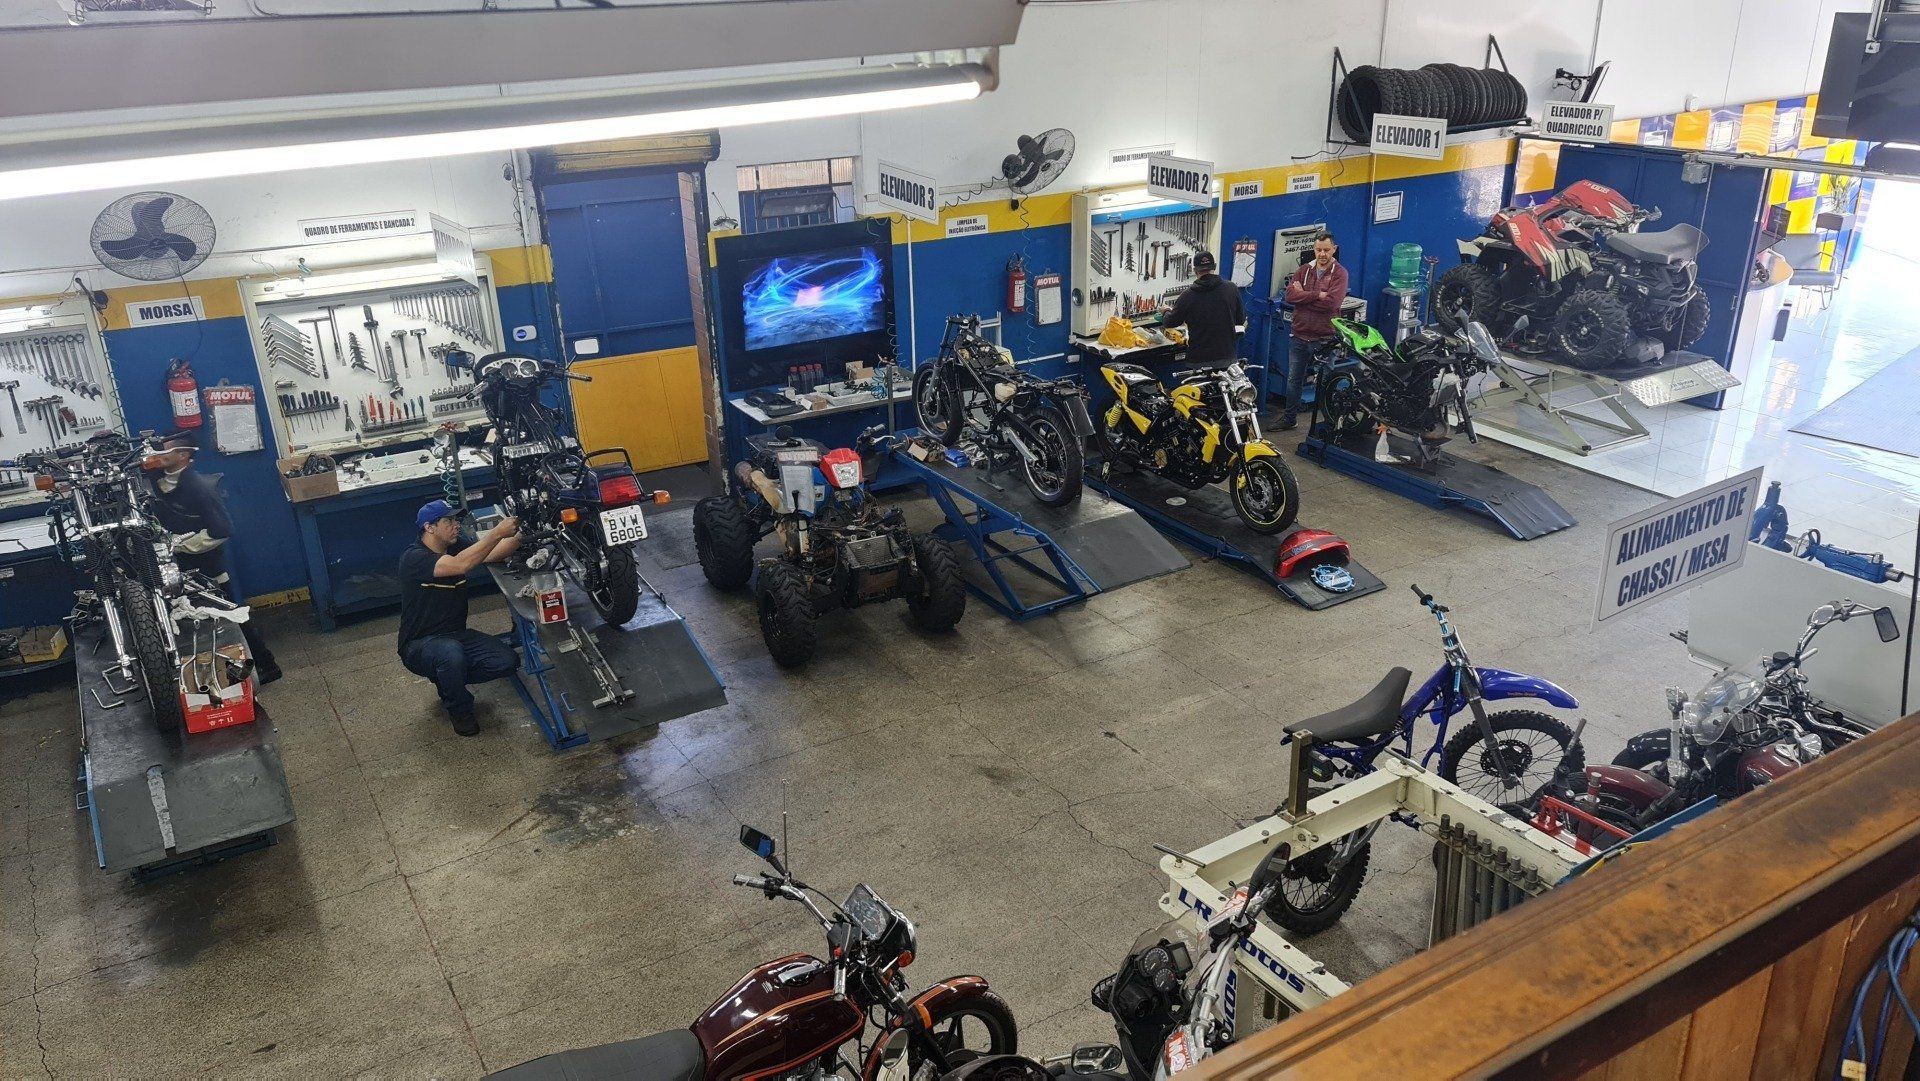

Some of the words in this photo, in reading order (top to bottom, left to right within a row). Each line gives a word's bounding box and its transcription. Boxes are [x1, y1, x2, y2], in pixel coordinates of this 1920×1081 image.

[1551, 106, 1592, 120] ELEVADOR
[1593, 109, 1604, 120] P/
[1376, 125, 1431, 148] ELEVADOR
[1434, 130, 1440, 149] 1
[1546, 121, 1603, 137] QUADRICICLO
[1150, 165, 1200, 193] ELEVADOR
[1201, 173, 1209, 194] 2
[880, 172, 926, 208] ELEVADOR
[928, 187, 935, 211] 3
[1234, 184, 1258, 197] MORSA
[304, 225, 330, 237] QUADRO
[330, 225, 338, 234] DE
[338, 221, 379, 233] FERRAMENTAS
[380, 220, 384, 229] E
[384, 218, 411, 229] BANCADA
[411, 217, 415, 227] 2
[1036, 277, 1060, 286] MOTUL
[139, 303, 193, 320] MORSA
[208, 391, 252, 401] MOTUL
[610, 525, 643, 542] 6806
[1616, 495, 1726, 566] ALINHAMENTO
[1725, 486, 1748, 522] DE
[1616, 555, 1677, 607] CHASSI
[1675, 549, 1689, 582] /
[1687, 533, 1731, 577] MESA
[1178, 887, 1213, 922] LR
[1238, 933, 1306, 994] otos
